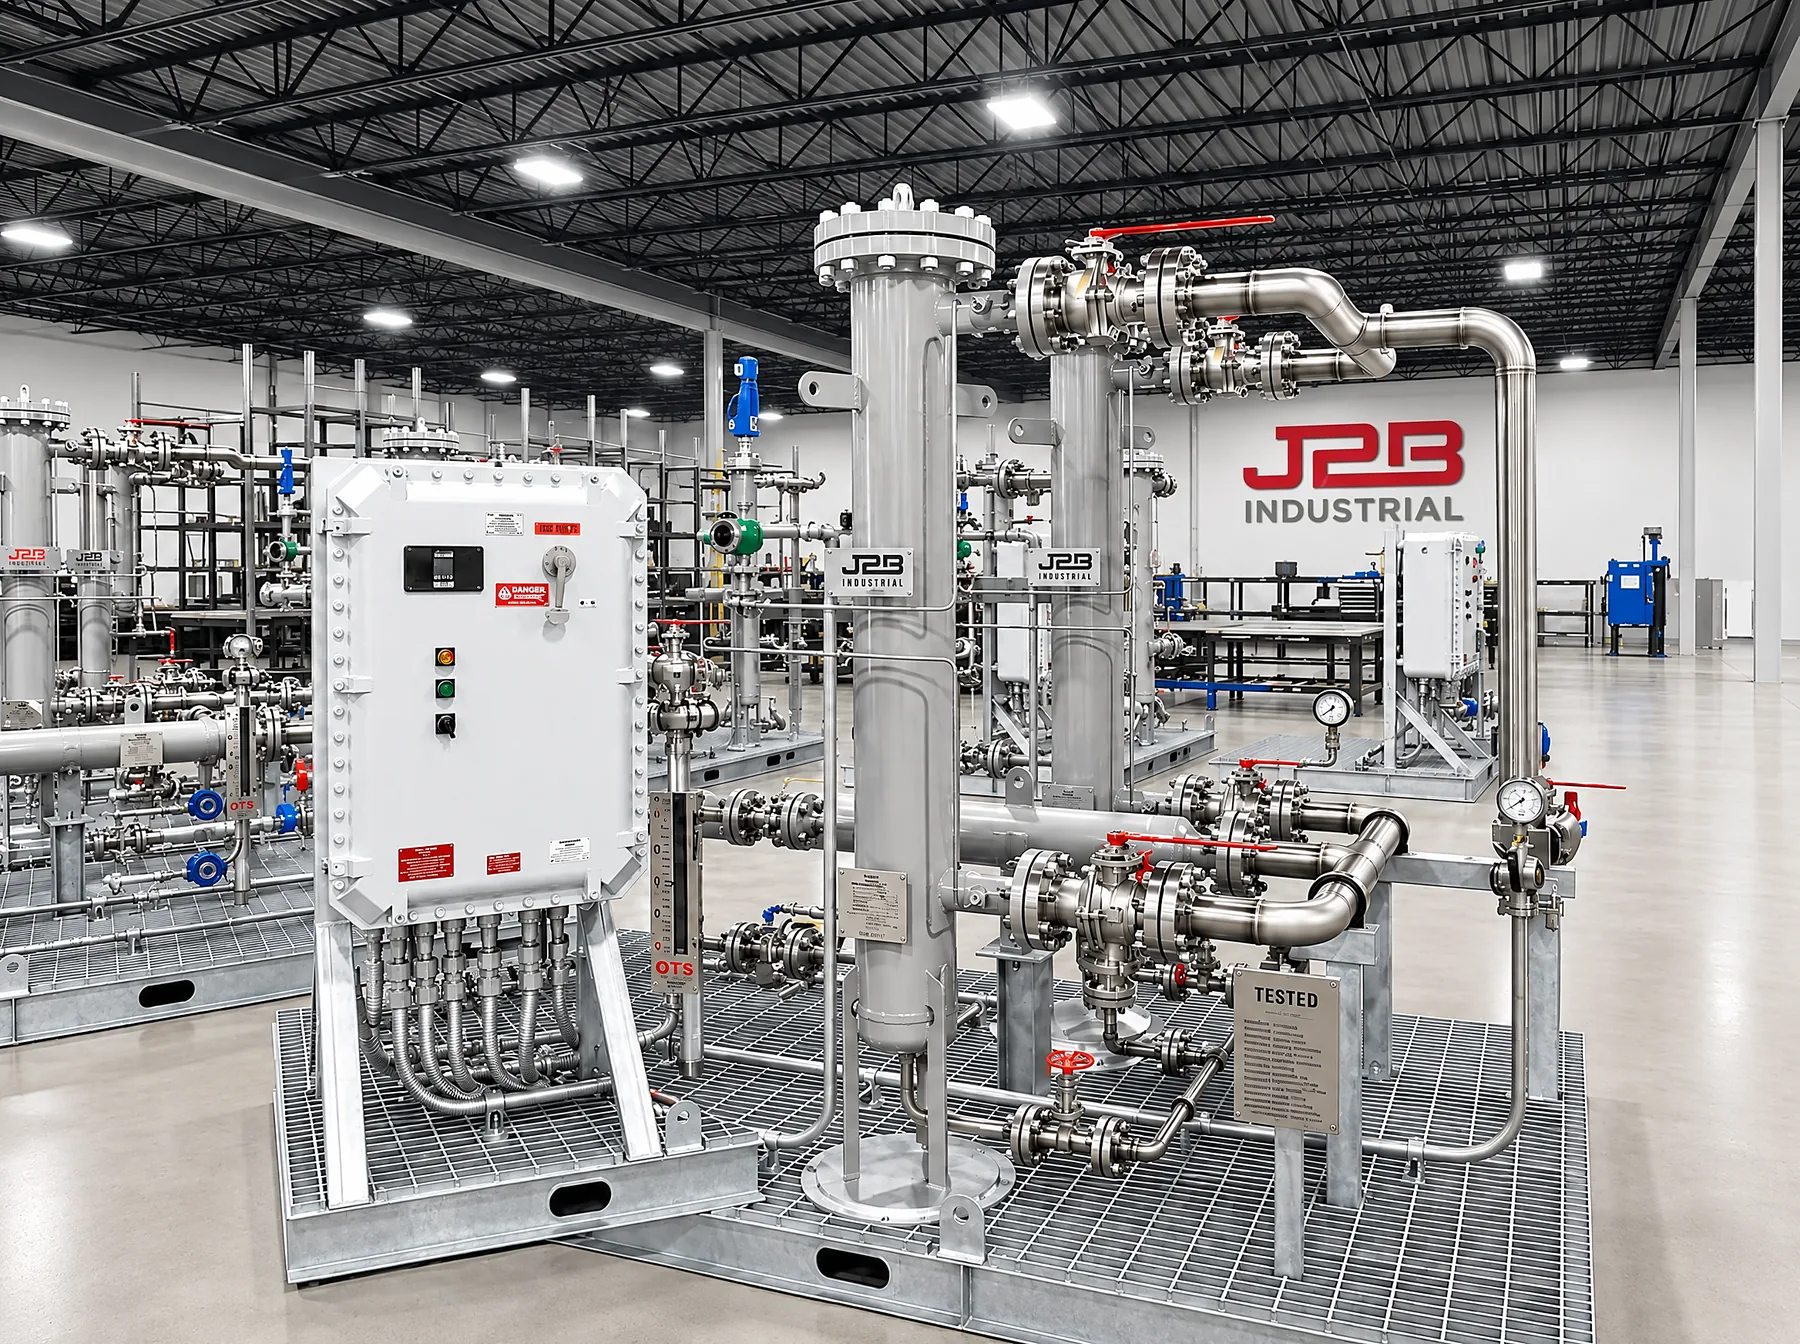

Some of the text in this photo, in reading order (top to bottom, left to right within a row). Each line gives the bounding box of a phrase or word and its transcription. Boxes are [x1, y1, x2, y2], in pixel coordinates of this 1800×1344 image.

[1243, 420, 1463, 490] J2B
[1245, 496, 1464, 524] INDUSTRIAL
[9, 549, 46, 560] J2B
[1038, 553, 1093, 570] J2B
[841, 554, 904, 575] J2B
[842, 578, 903, 587] INDUSTRIAL
[1038, 572, 1092, 580] INDUSTRIAL
[512, 586, 546, 594] DANGER
[230, 800, 254, 811] OTS
[655, 960, 694, 976] OTS
[1254, 986, 1319, 1008] TESTED
